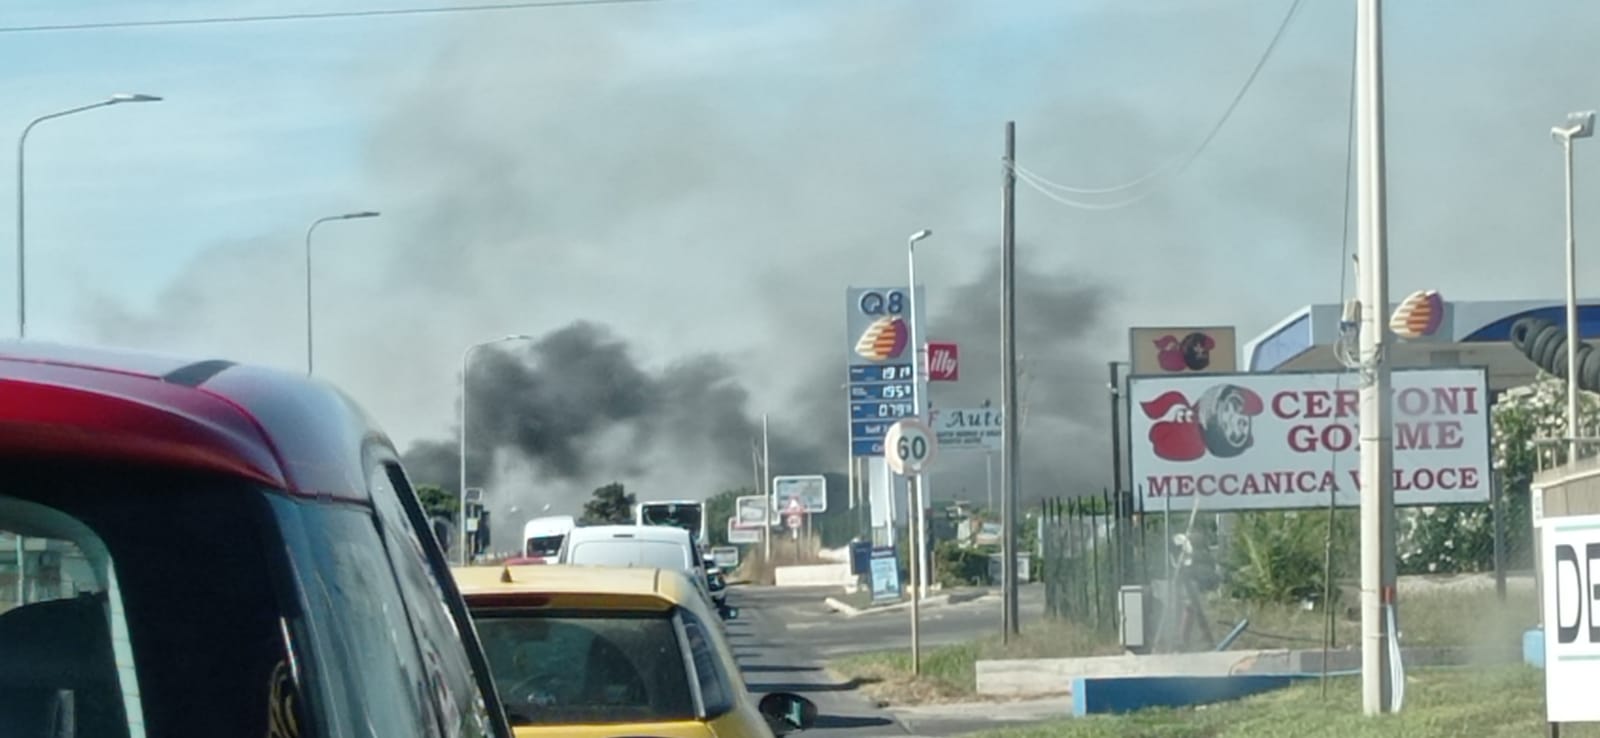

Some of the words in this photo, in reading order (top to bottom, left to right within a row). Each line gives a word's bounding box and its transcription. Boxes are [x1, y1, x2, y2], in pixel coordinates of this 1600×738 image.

[859, 290, 903, 316] Q8
[930, 349, 956, 378] illy
[1271, 387, 1479, 419] CERONI
[896, 435, 927, 461] 60
[1287, 420, 1464, 453] GOME
[1147, 470, 1340, 499] MECCANICA
[1348, 467, 1479, 492] VLOCE
